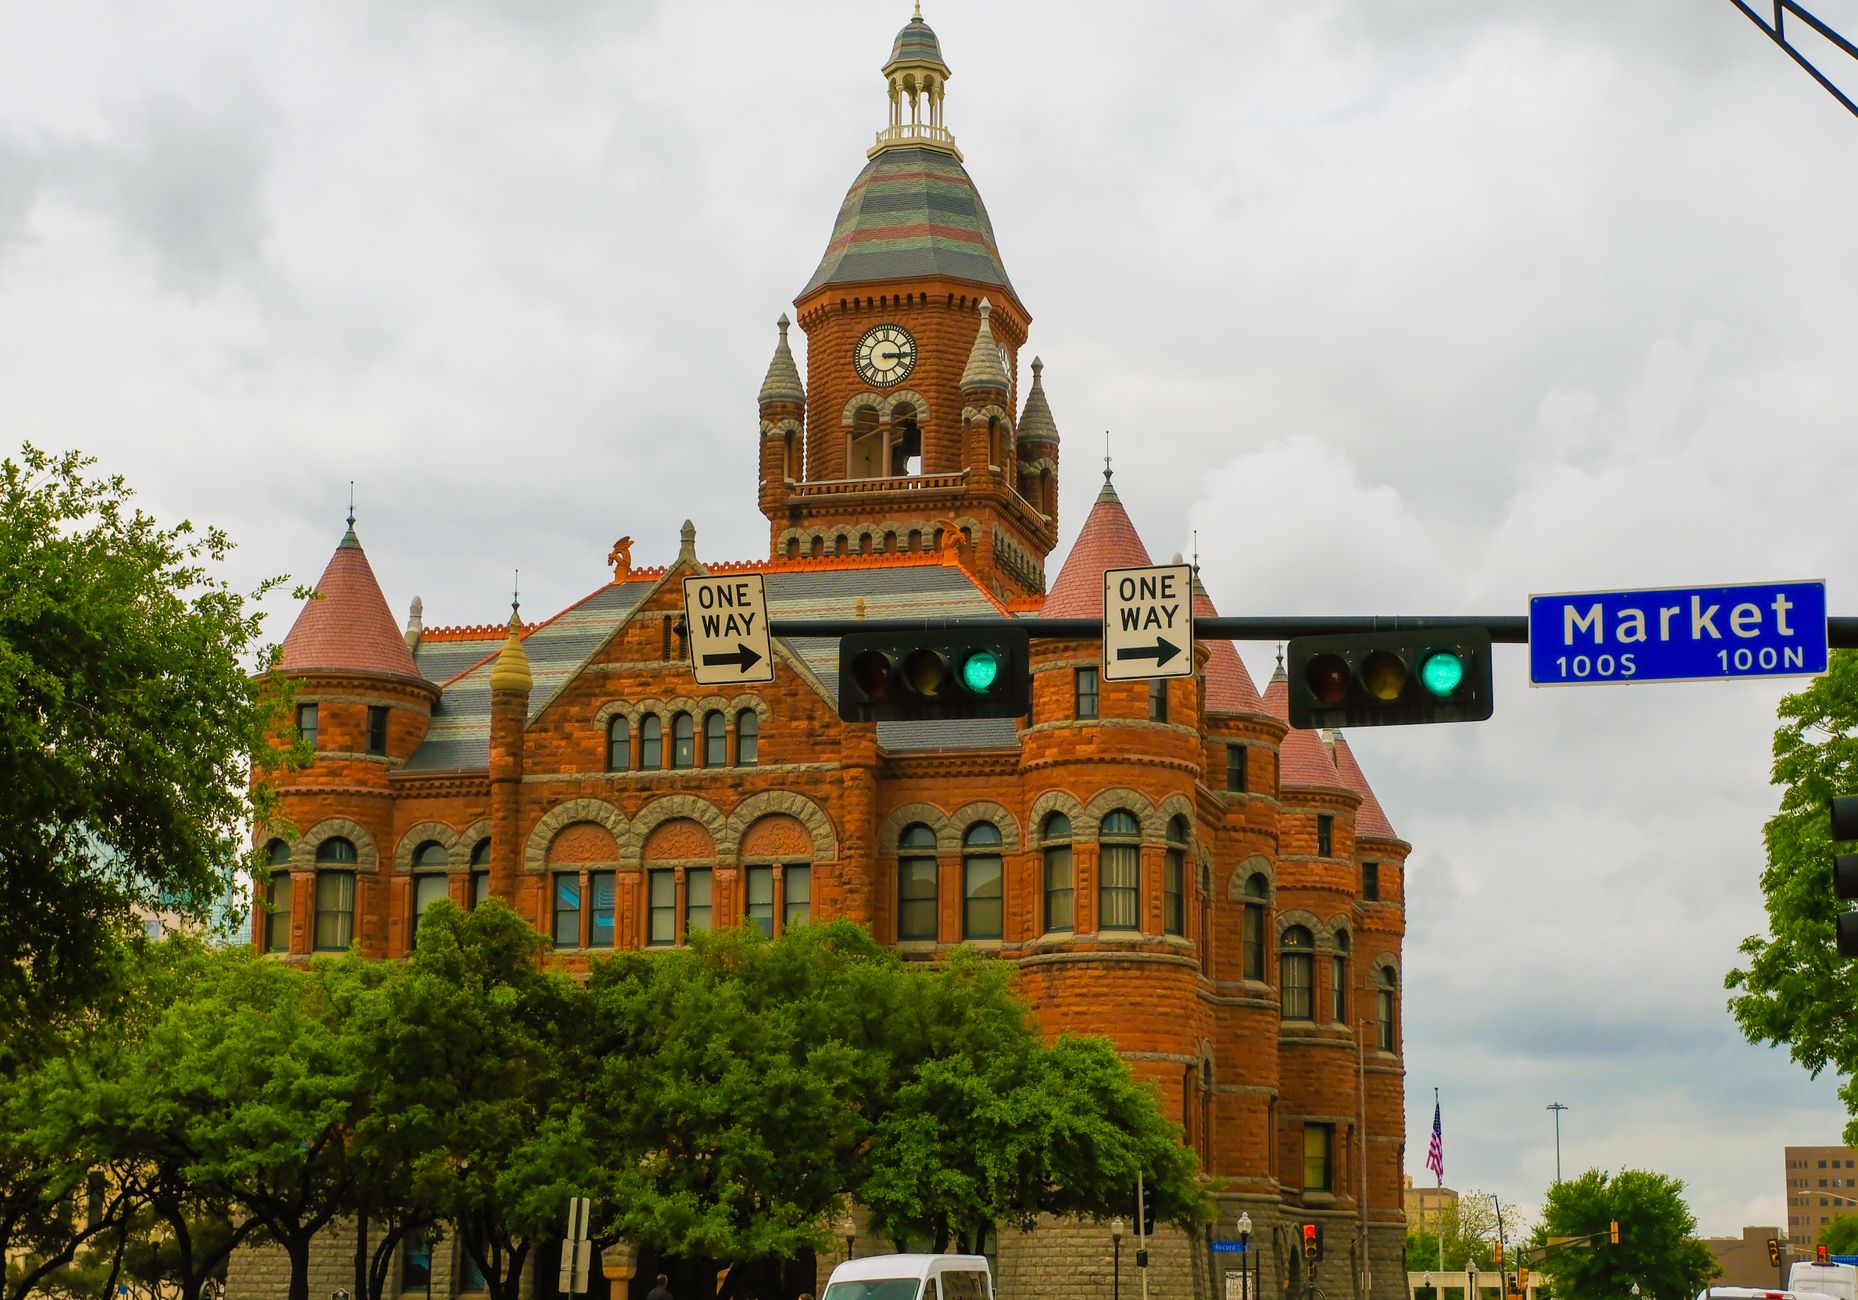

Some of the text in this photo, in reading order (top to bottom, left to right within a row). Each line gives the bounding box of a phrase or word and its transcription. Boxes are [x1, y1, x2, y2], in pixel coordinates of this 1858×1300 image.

[698, 583, 752, 609] ONE
[1119, 575, 1176, 602] ONE
[701, 612, 756, 638] WAY
[1120, 604, 1179, 632] WAY
[1563, 593, 1794, 646] Market
[1556, 646, 1804, 678] 100S 100N
